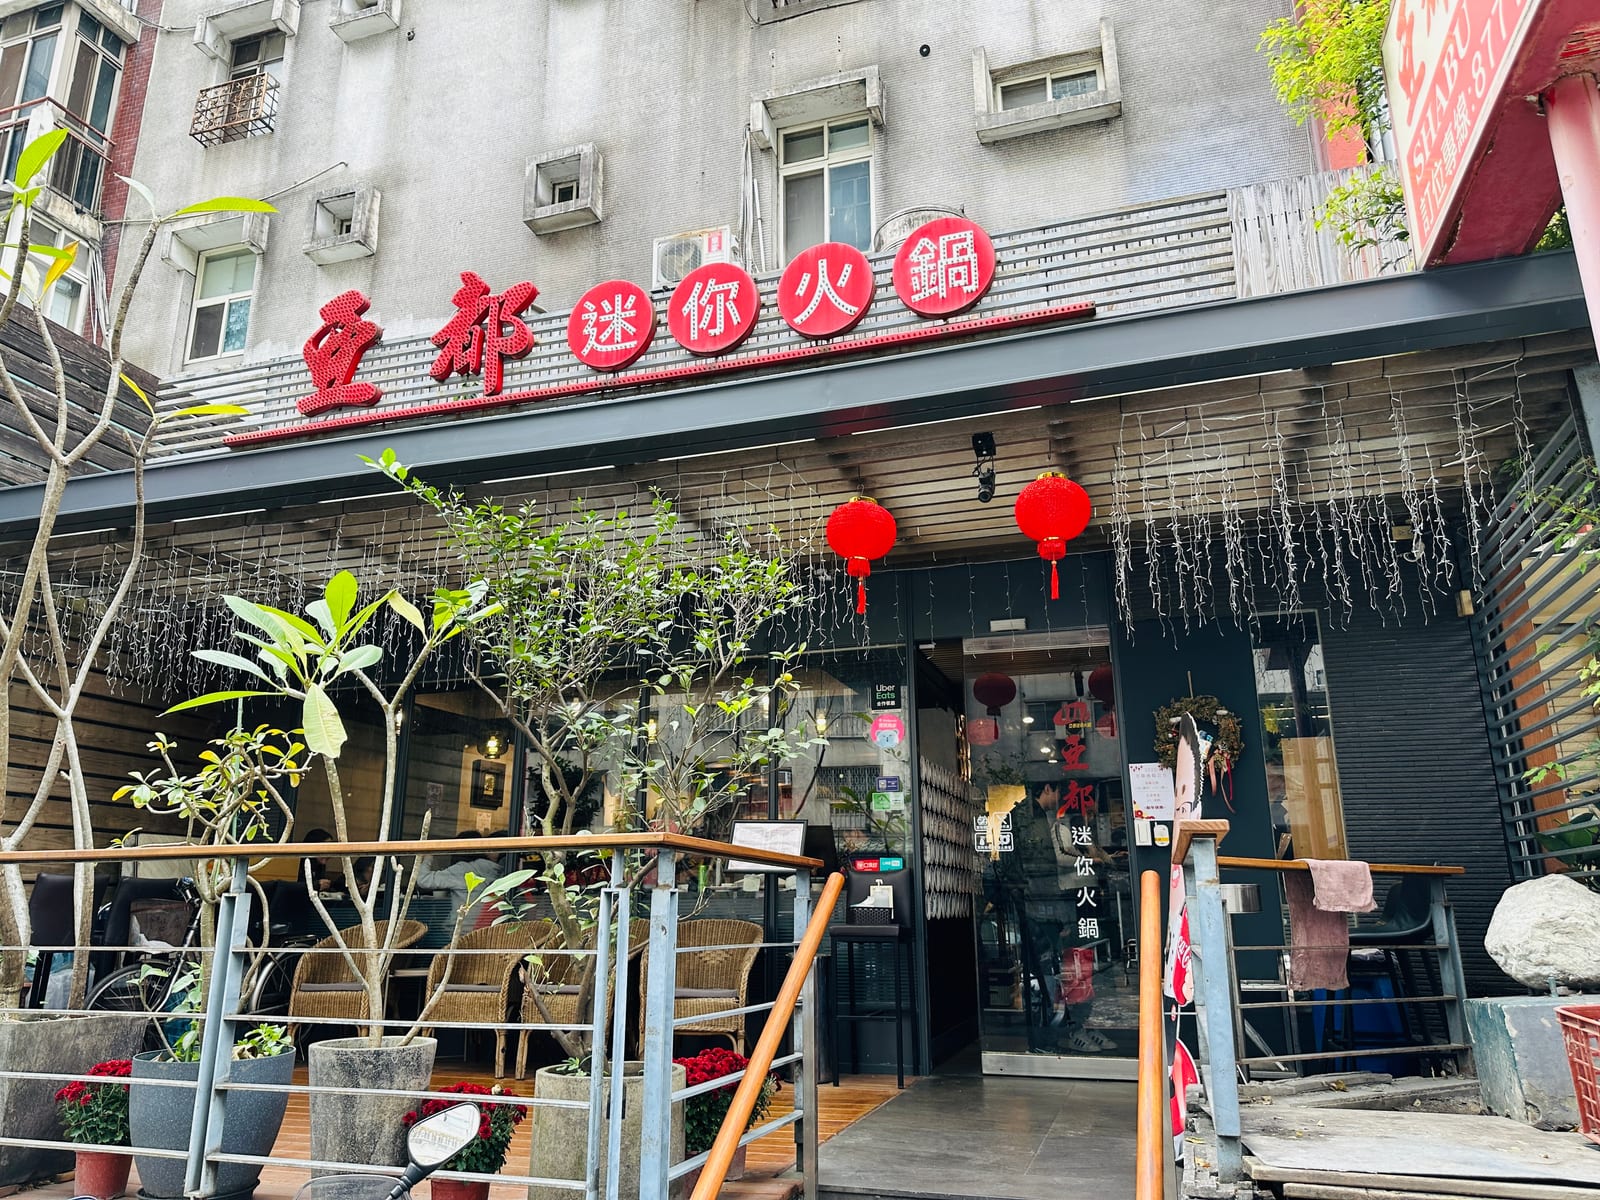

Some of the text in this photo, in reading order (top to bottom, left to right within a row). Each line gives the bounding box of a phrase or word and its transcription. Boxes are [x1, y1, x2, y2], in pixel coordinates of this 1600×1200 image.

[1413, 2, 1470, 184] SHABU
[1420, 0, 1523, 236] 訂位專線:877
